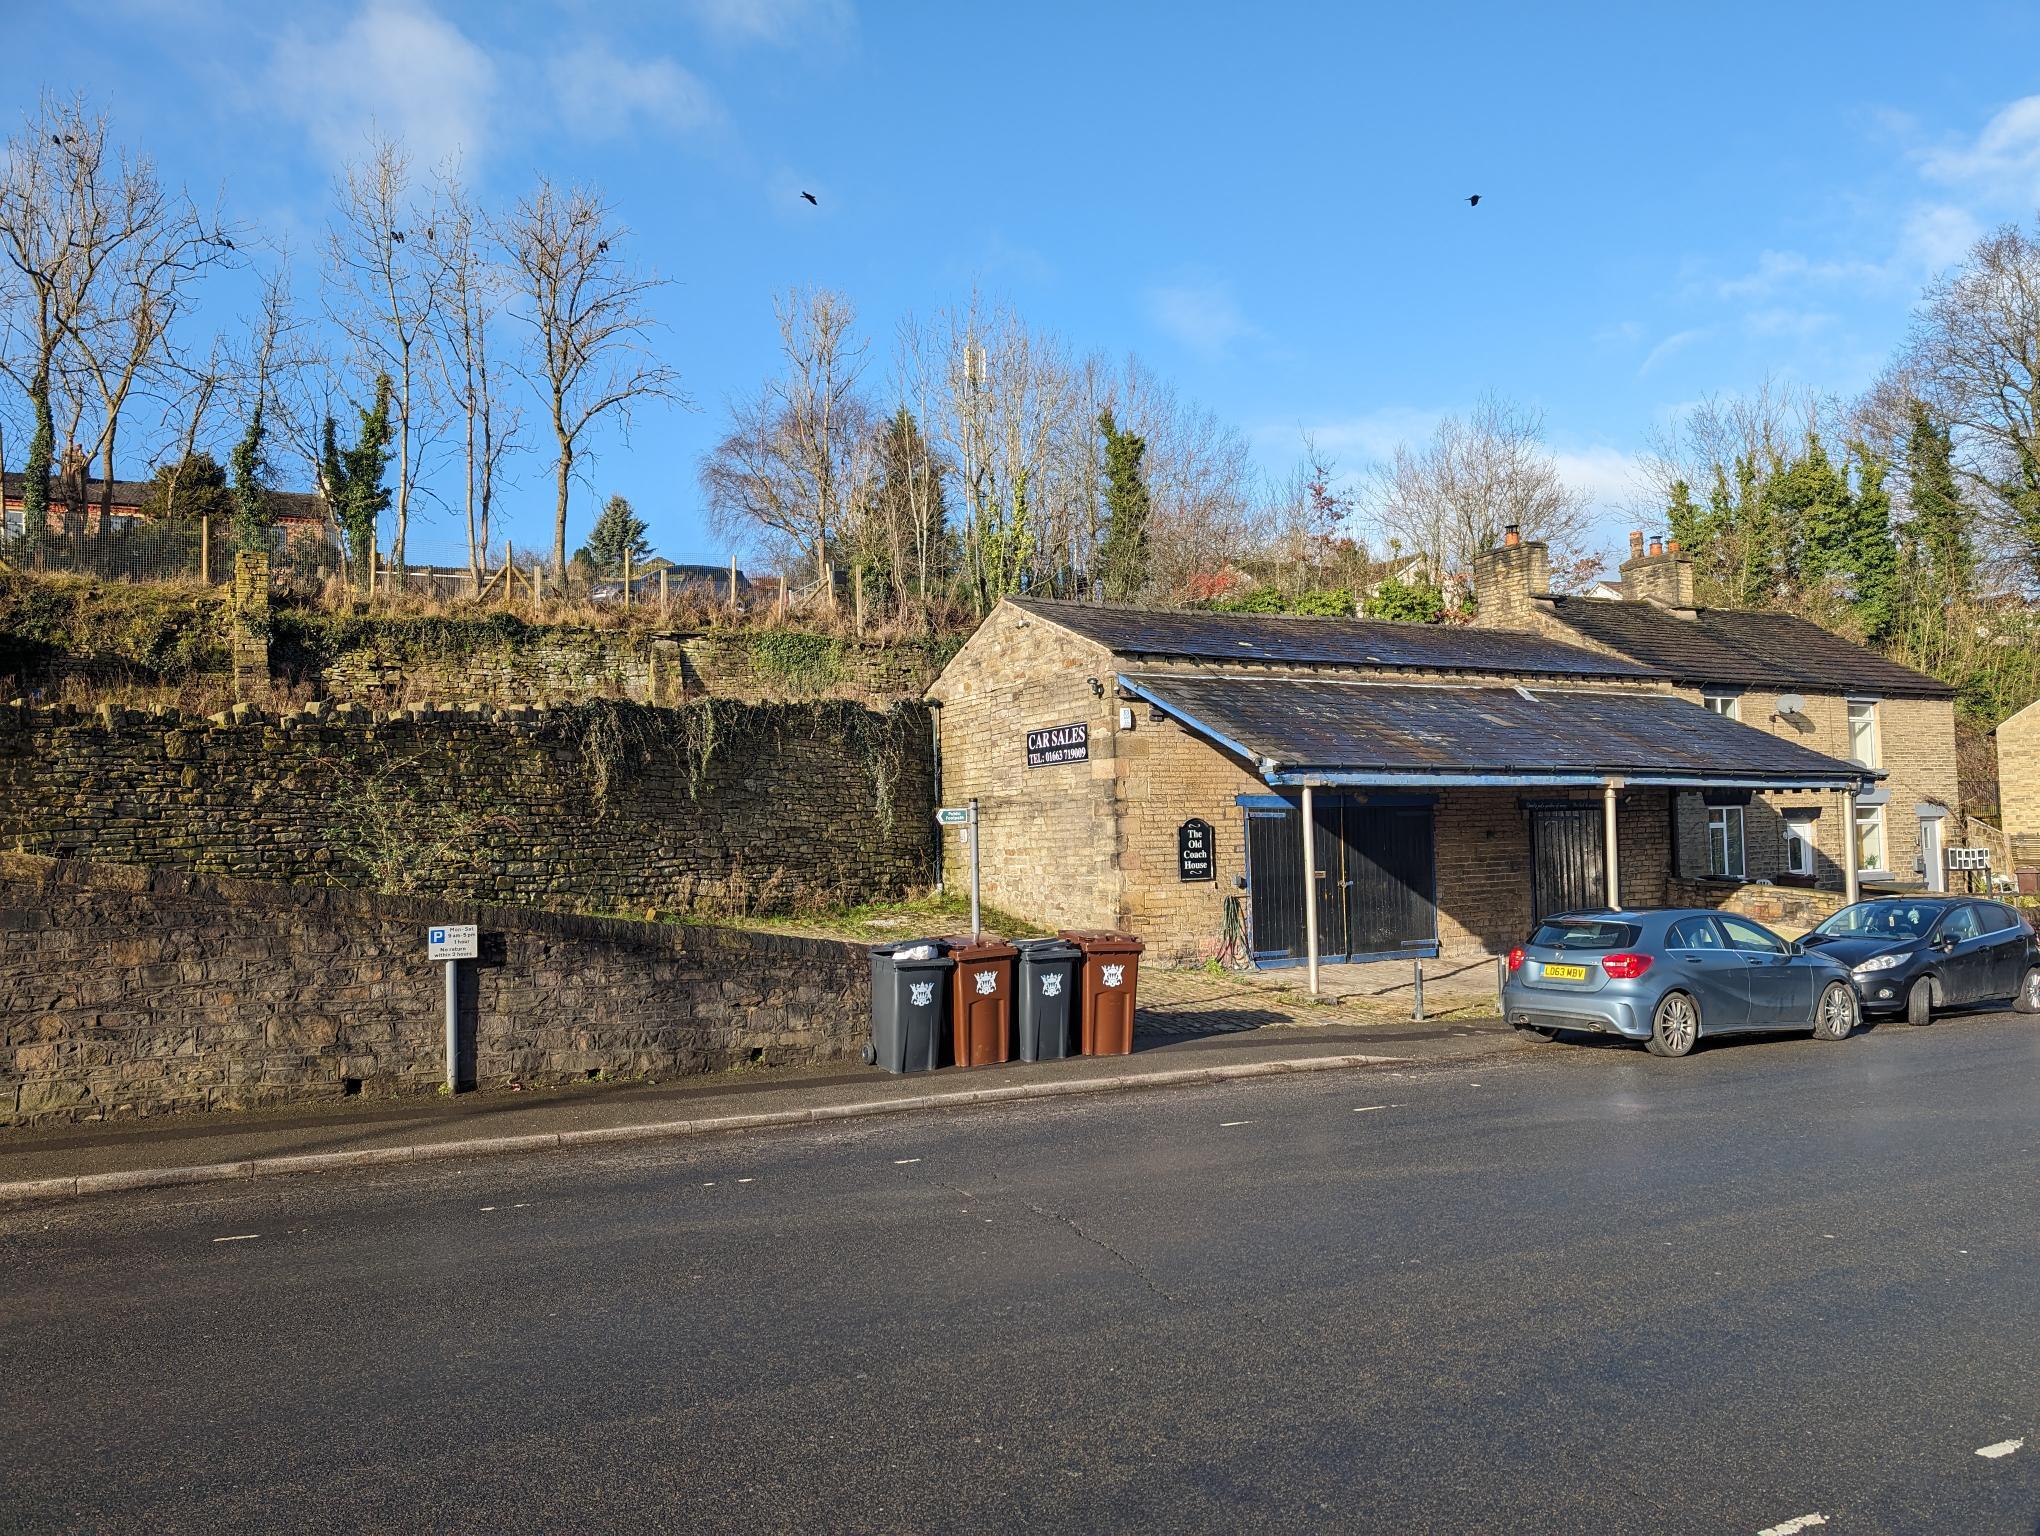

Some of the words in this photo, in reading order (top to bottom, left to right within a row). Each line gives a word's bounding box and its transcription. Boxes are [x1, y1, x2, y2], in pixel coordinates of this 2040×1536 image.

[1029, 733, 1050, 750] CAR
[1051, 727, 1085, 746] SALES
[1029, 753, 1044, 764] TEL:
[1045, 750, 1063, 762] 01663
[1188, 830, 1202, 838] The
[1188, 840, 1202, 849] Old
[1183, 850, 1207, 859] Coach
[1184, 861, 1207, 869] House
[434, 932, 443, 942] P
[1567, 968, 1583, 977] MBV
